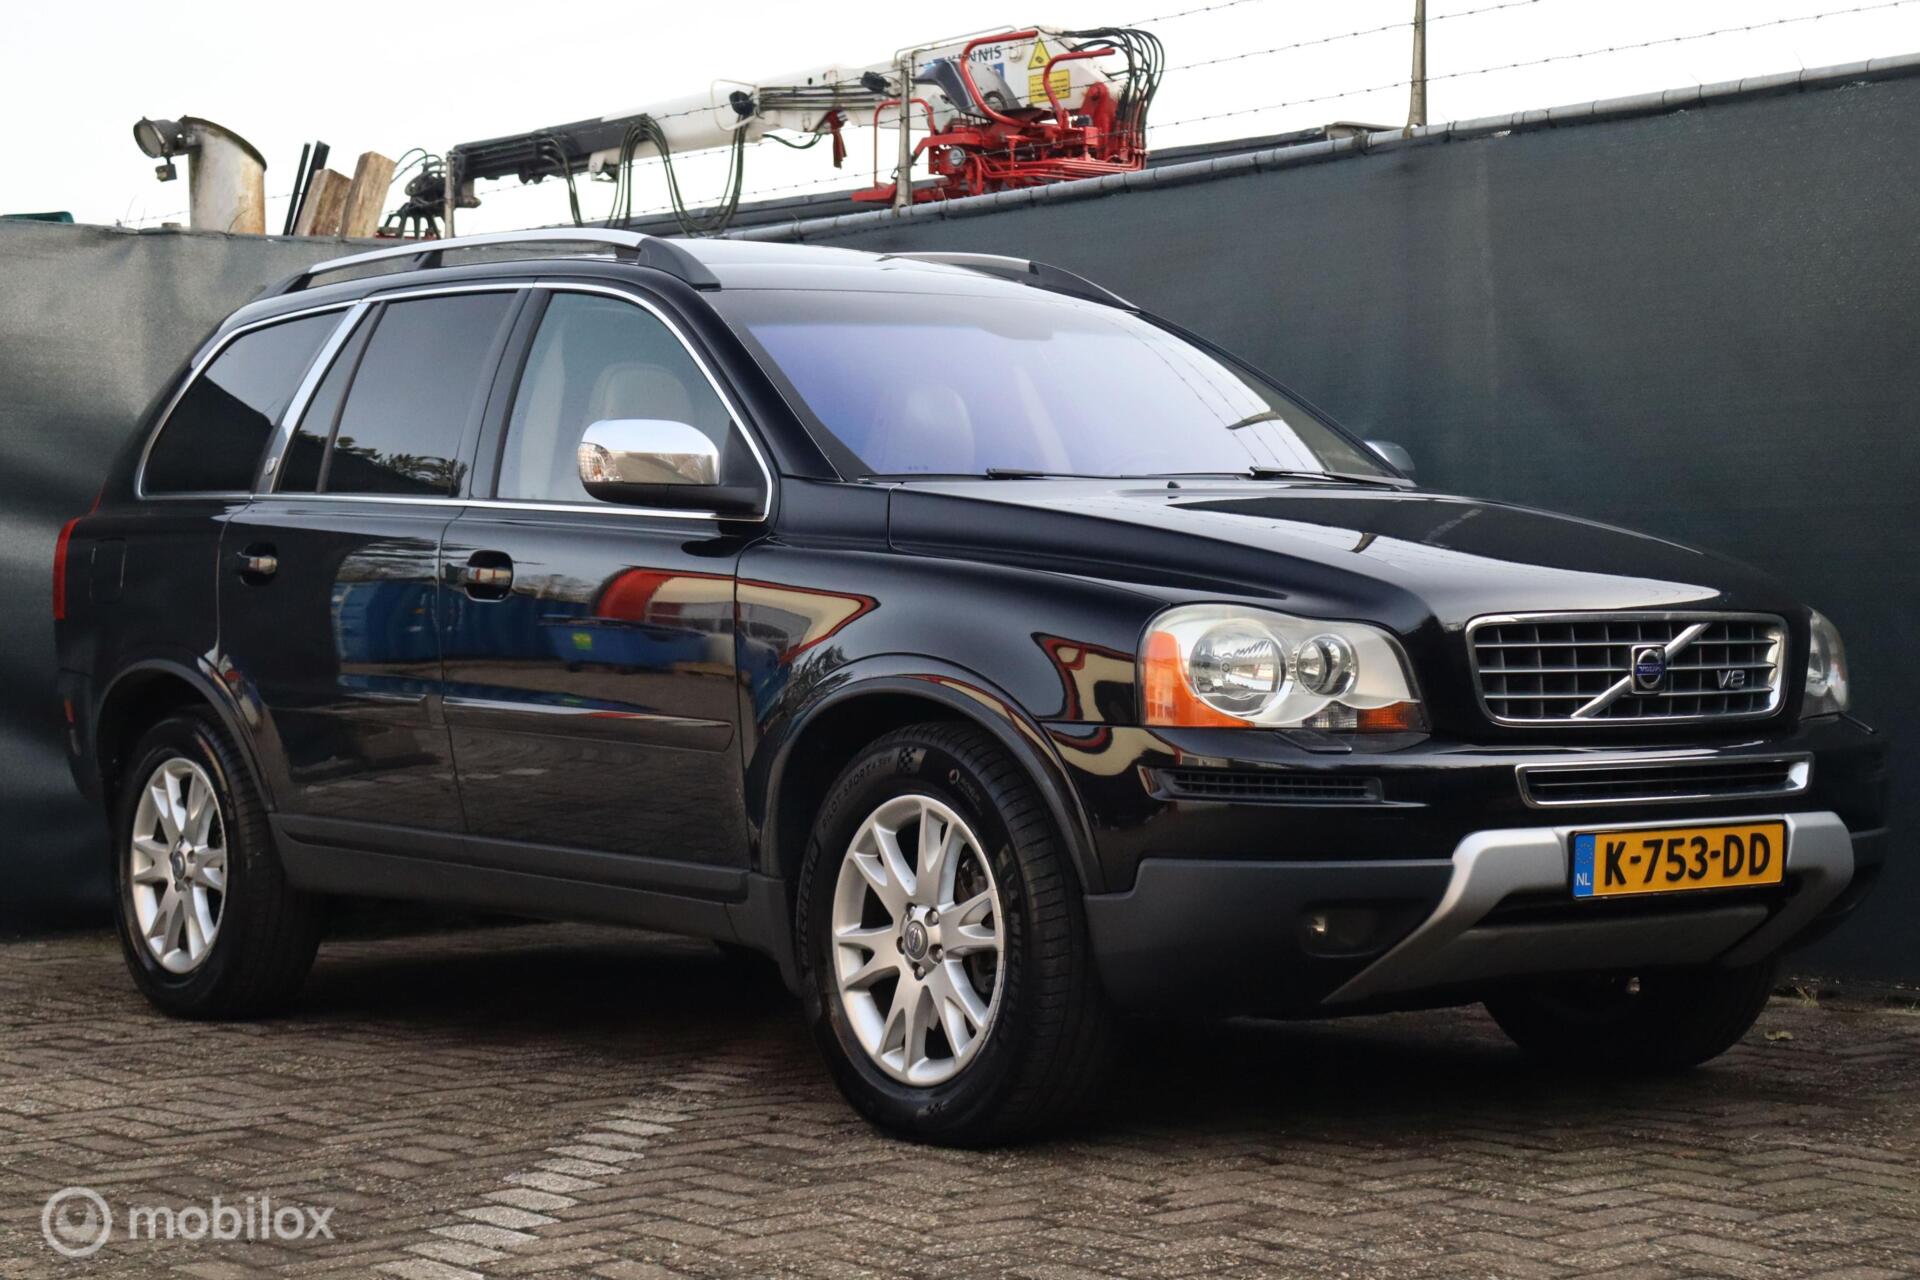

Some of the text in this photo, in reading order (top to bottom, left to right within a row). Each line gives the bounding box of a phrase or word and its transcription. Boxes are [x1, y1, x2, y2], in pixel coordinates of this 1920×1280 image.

[1716, 669, 1745, 690] V8
[1604, 832, 1771, 887] K-753-DD
[1576, 872, 1591, 887] NL
